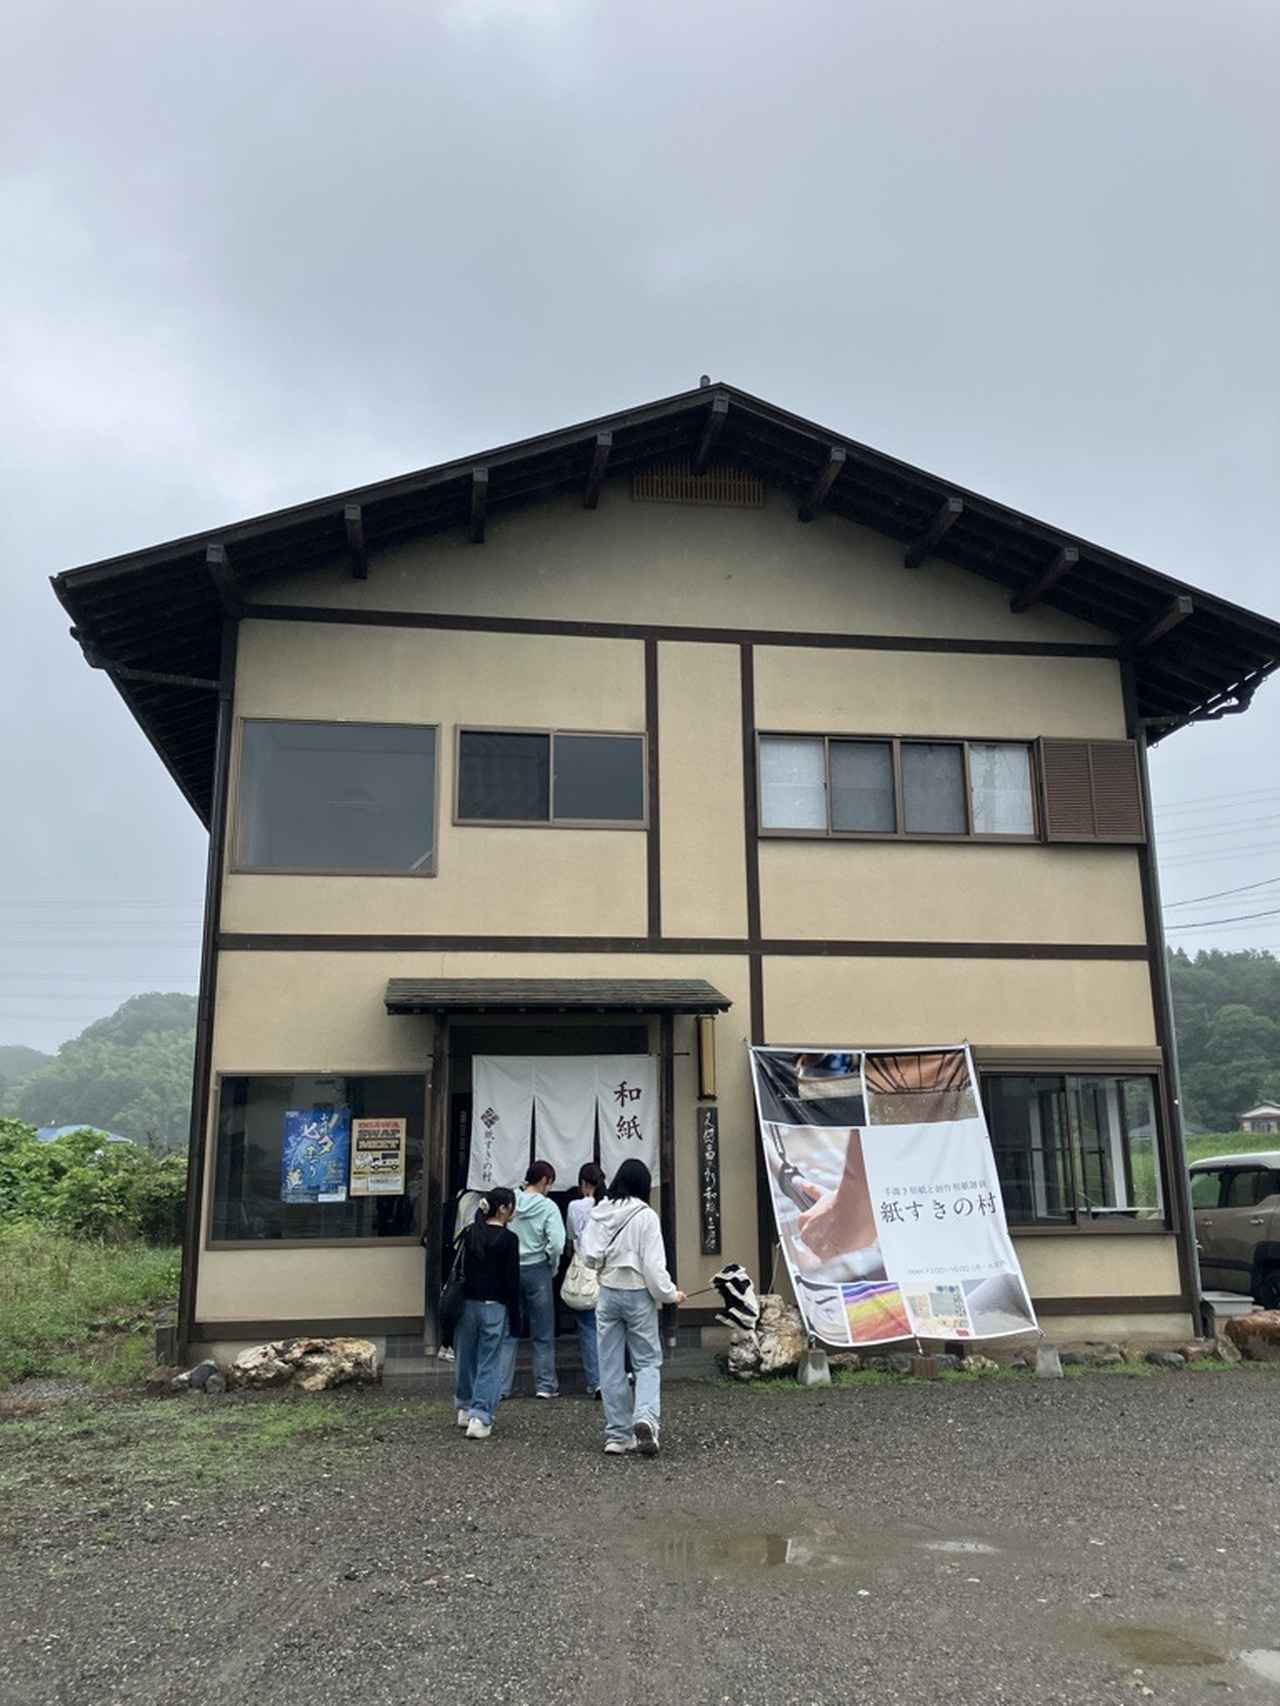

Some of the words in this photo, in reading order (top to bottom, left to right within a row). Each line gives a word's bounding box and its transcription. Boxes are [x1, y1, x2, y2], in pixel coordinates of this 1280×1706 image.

[613, 1080, 643, 1140] 和紙
[880, 1191, 997, 1223] 紙すきの村
